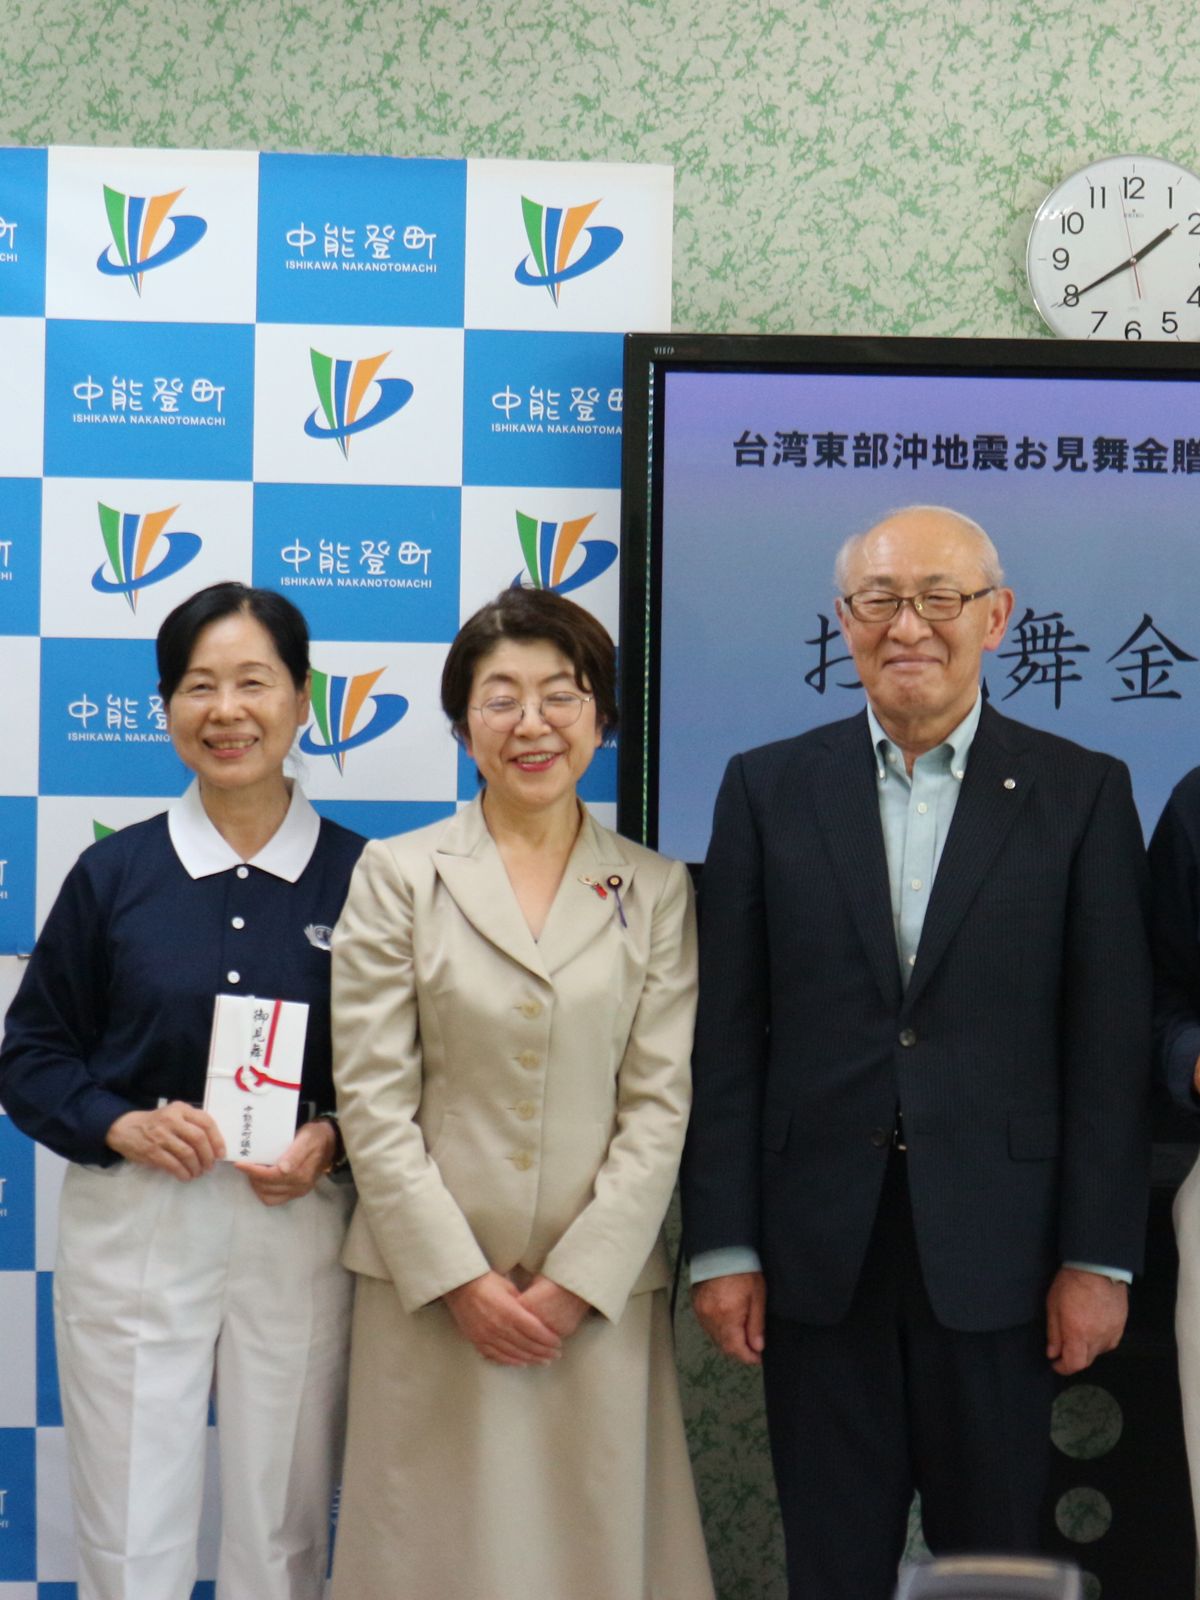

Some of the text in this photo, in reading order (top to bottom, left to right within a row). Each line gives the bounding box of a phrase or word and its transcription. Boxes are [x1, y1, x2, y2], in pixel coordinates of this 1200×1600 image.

[1090, 186, 1106, 209] 11
[1123, 176, 1145, 200] 12
[1167, 186, 1173, 209] 1
[1061, 211, 1085, 235] 10
[286, 221, 437, 260] 中能登町
[286, 260, 437, 273] ISHIKAWA NAKANOTOMACHI
[1052, 247, 1070, 271] 9
[1063, 283, 1080, 307] 8
[1091, 311, 1108, 334] 7
[1124, 320, 1142, 341] 6
[1161, 311, 1178, 334] 5
[73, 375, 225, 413] 中能登町
[73, 413, 226, 426] ISHIKAWA NAKANOTOMACHI
[491, 423, 622, 435] ISHIKAWA NAKANOTOMA
[281, 538, 431, 575] 中能登町
[281, 577, 432, 588] ISHIKAWA NAKANOTOMACHI
[68, 693, 167, 730] 中能登
[68, 732, 121, 742] ISHIKAWA
